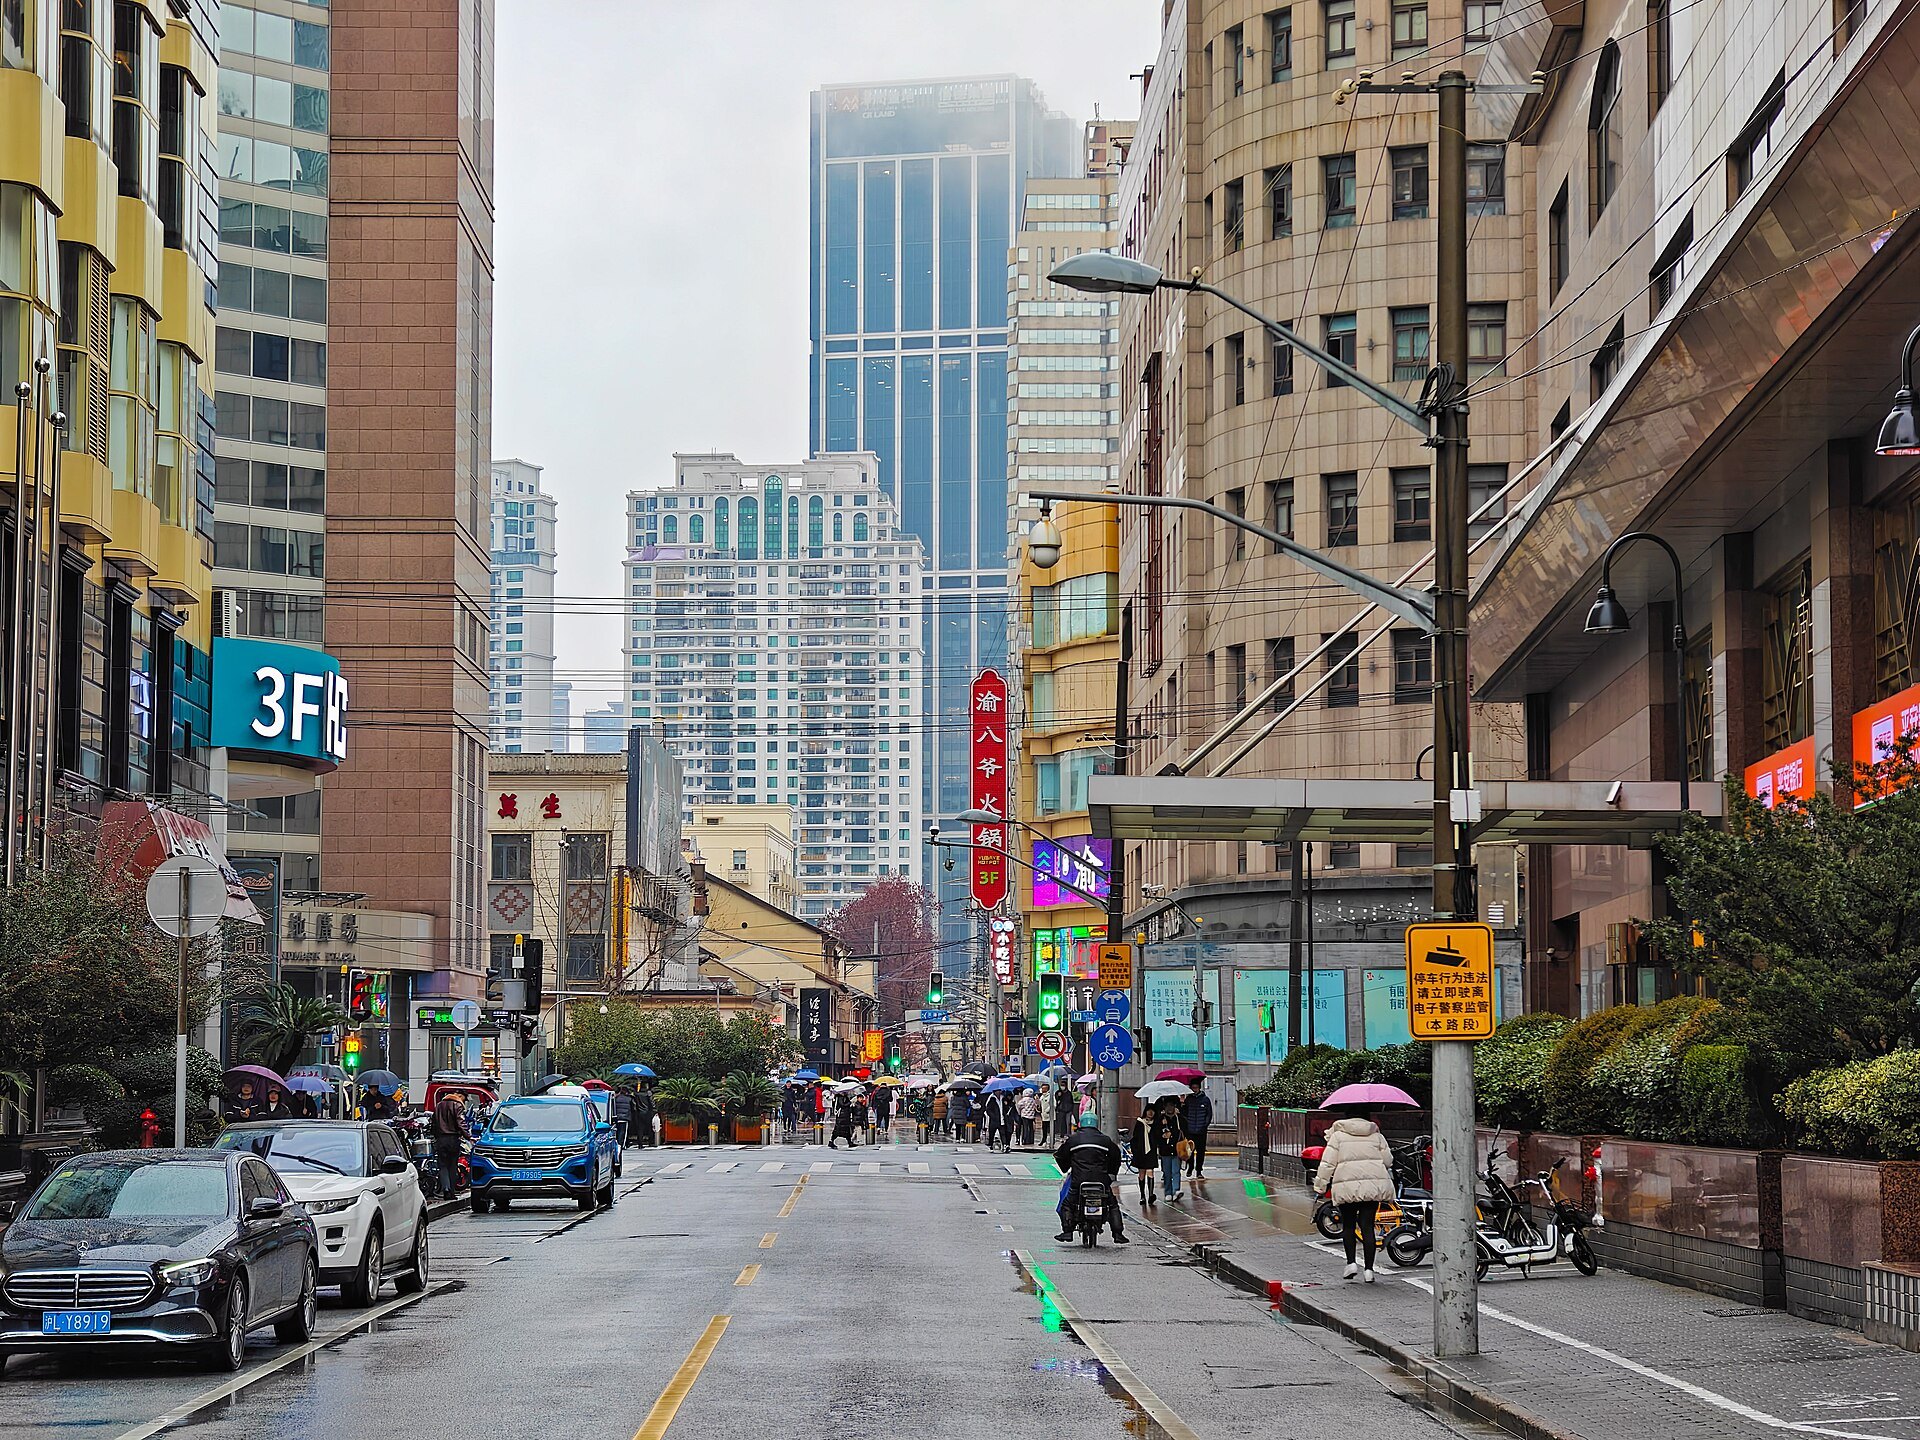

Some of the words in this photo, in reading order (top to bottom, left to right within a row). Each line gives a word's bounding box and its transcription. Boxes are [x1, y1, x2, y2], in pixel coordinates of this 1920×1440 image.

[976, 690, 1003, 848] 渝八爷火锅
[1777, 758, 1802, 792] 平安银行
[980, 871, 999, 884] 3F
[996, 932, 1010, 974] 小吃街
[1414, 972, 1488, 984] 停车行为违法
[1417, 986, 1484, 999] 请立即驶离
[1043, 994, 1059, 1009] 09
[1414, 1001, 1489, 1014] 电子警察监管
